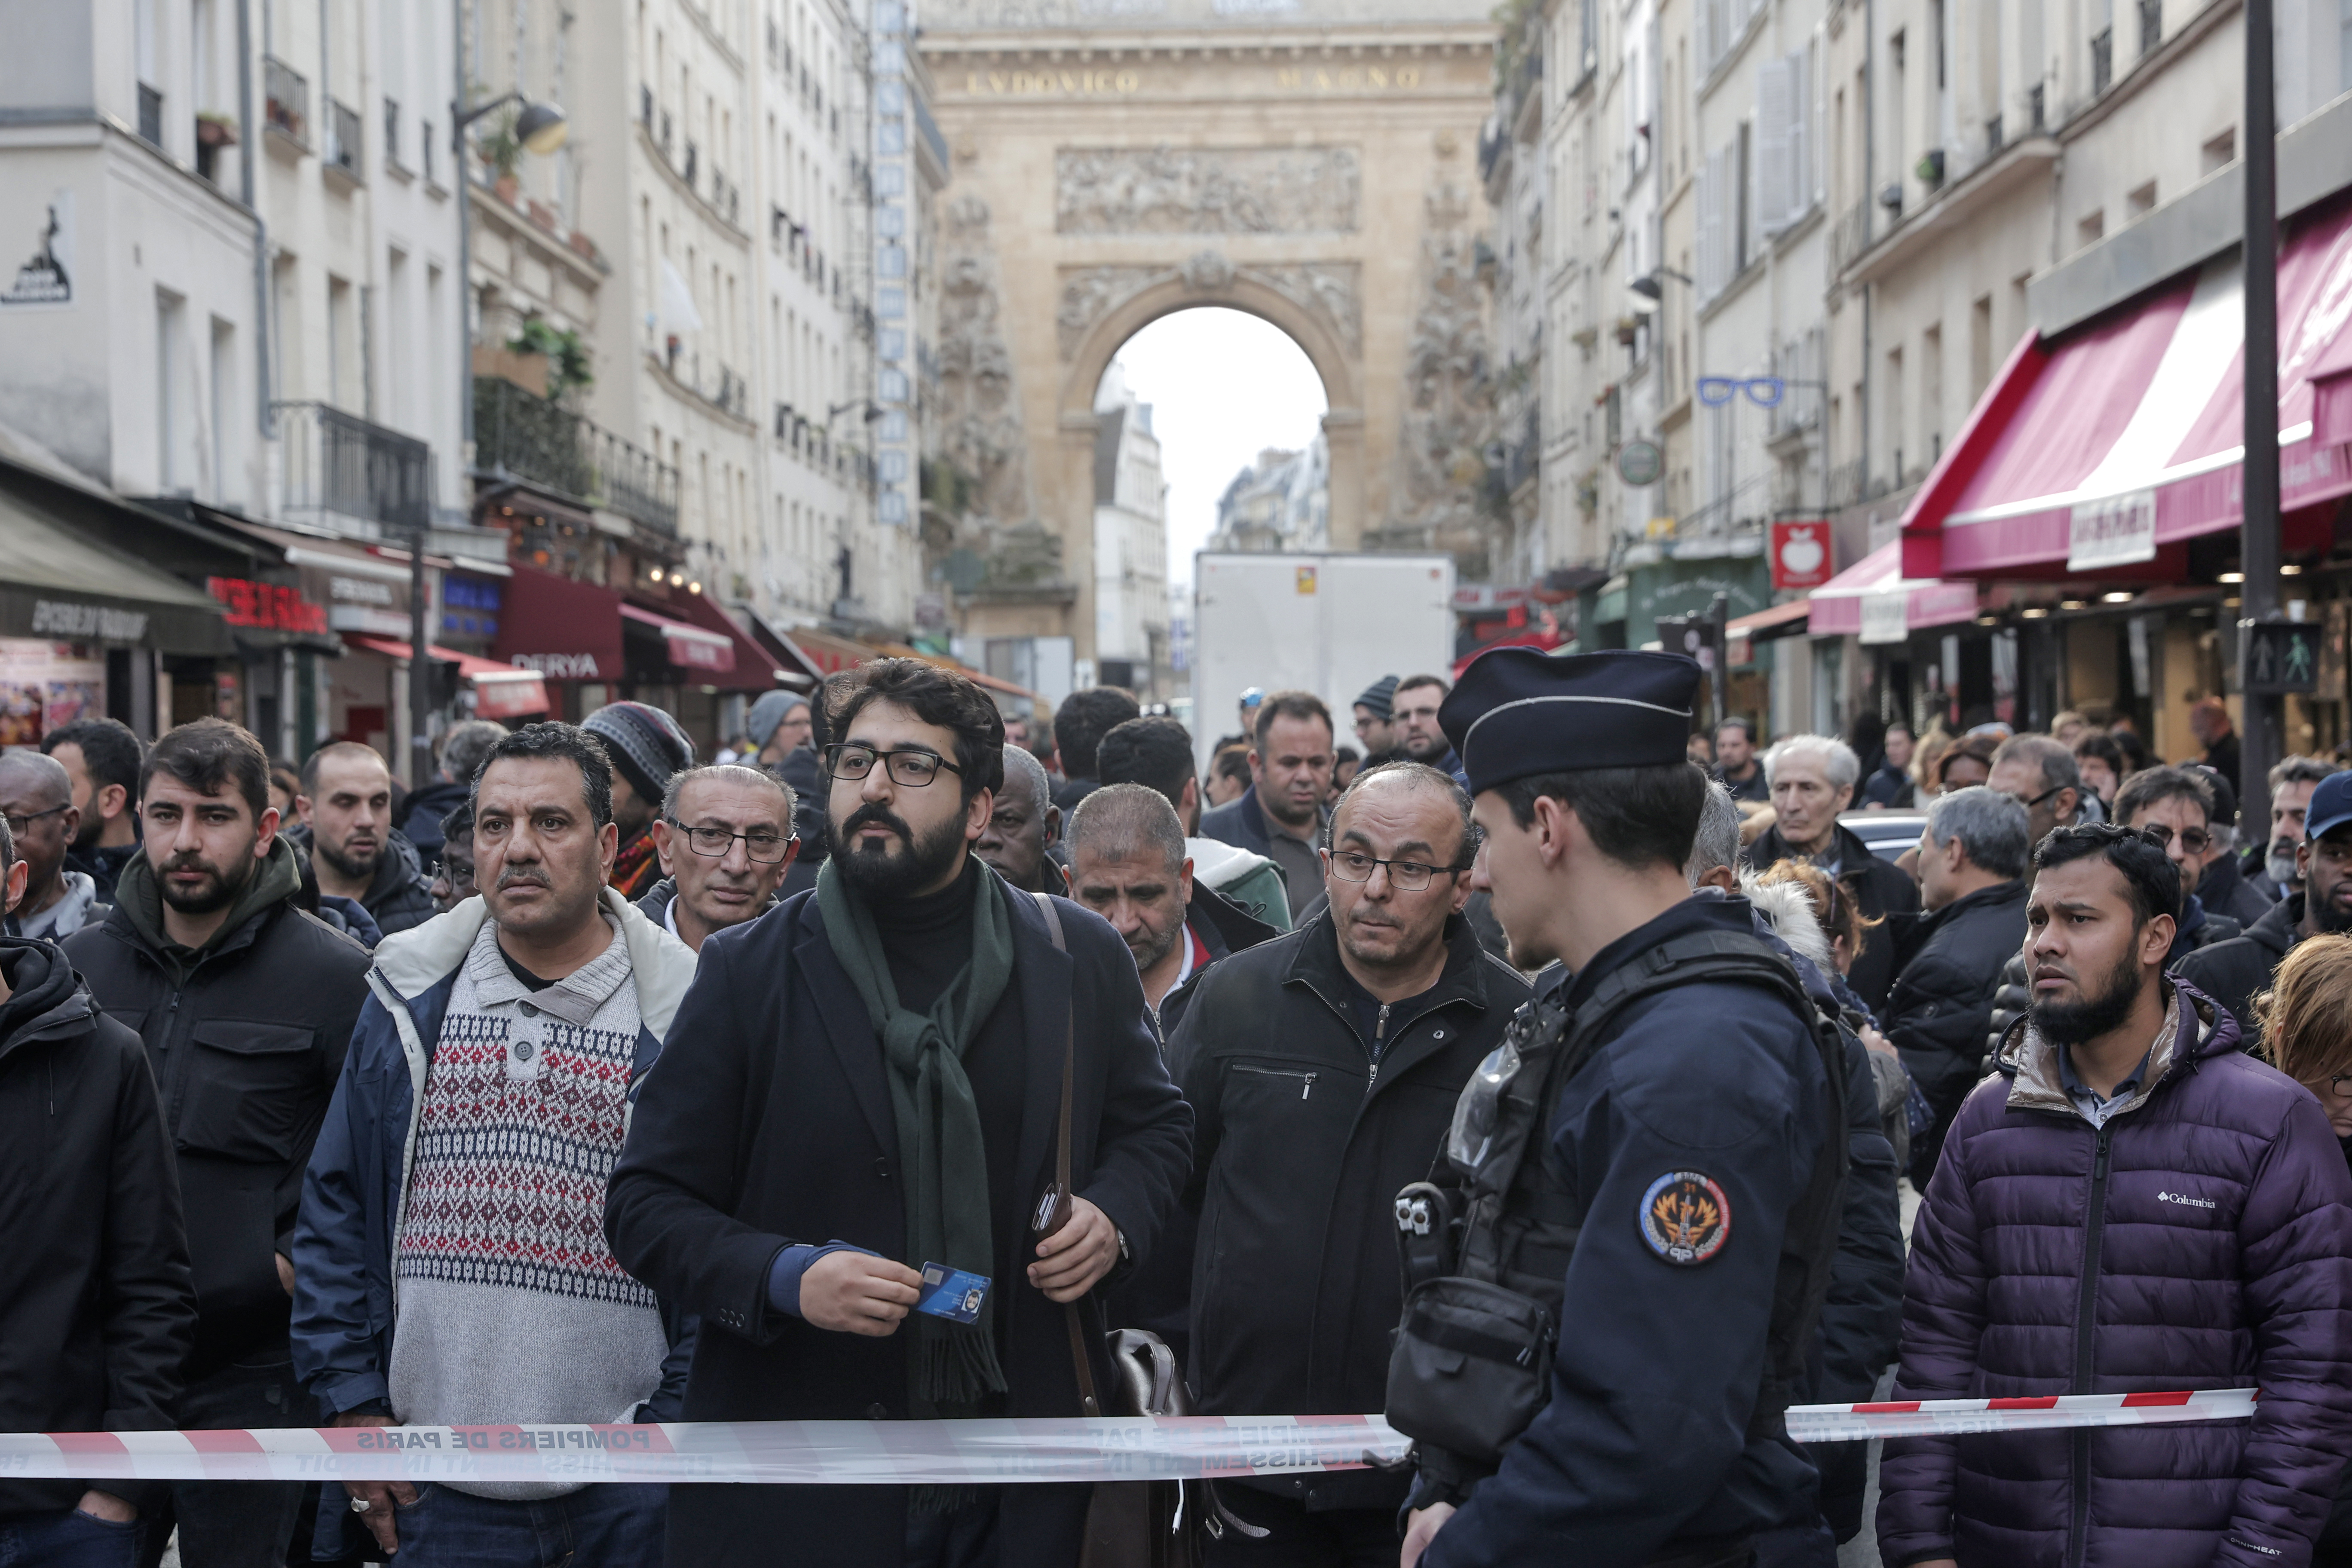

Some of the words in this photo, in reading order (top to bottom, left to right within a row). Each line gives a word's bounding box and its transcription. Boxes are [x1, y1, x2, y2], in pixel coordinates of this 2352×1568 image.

[511, 653, 599, 678] DERYA
[2169, 1193, 2215, 1209] Columbia
[2230, 1537, 2282, 1556] OMNI-HEAT
